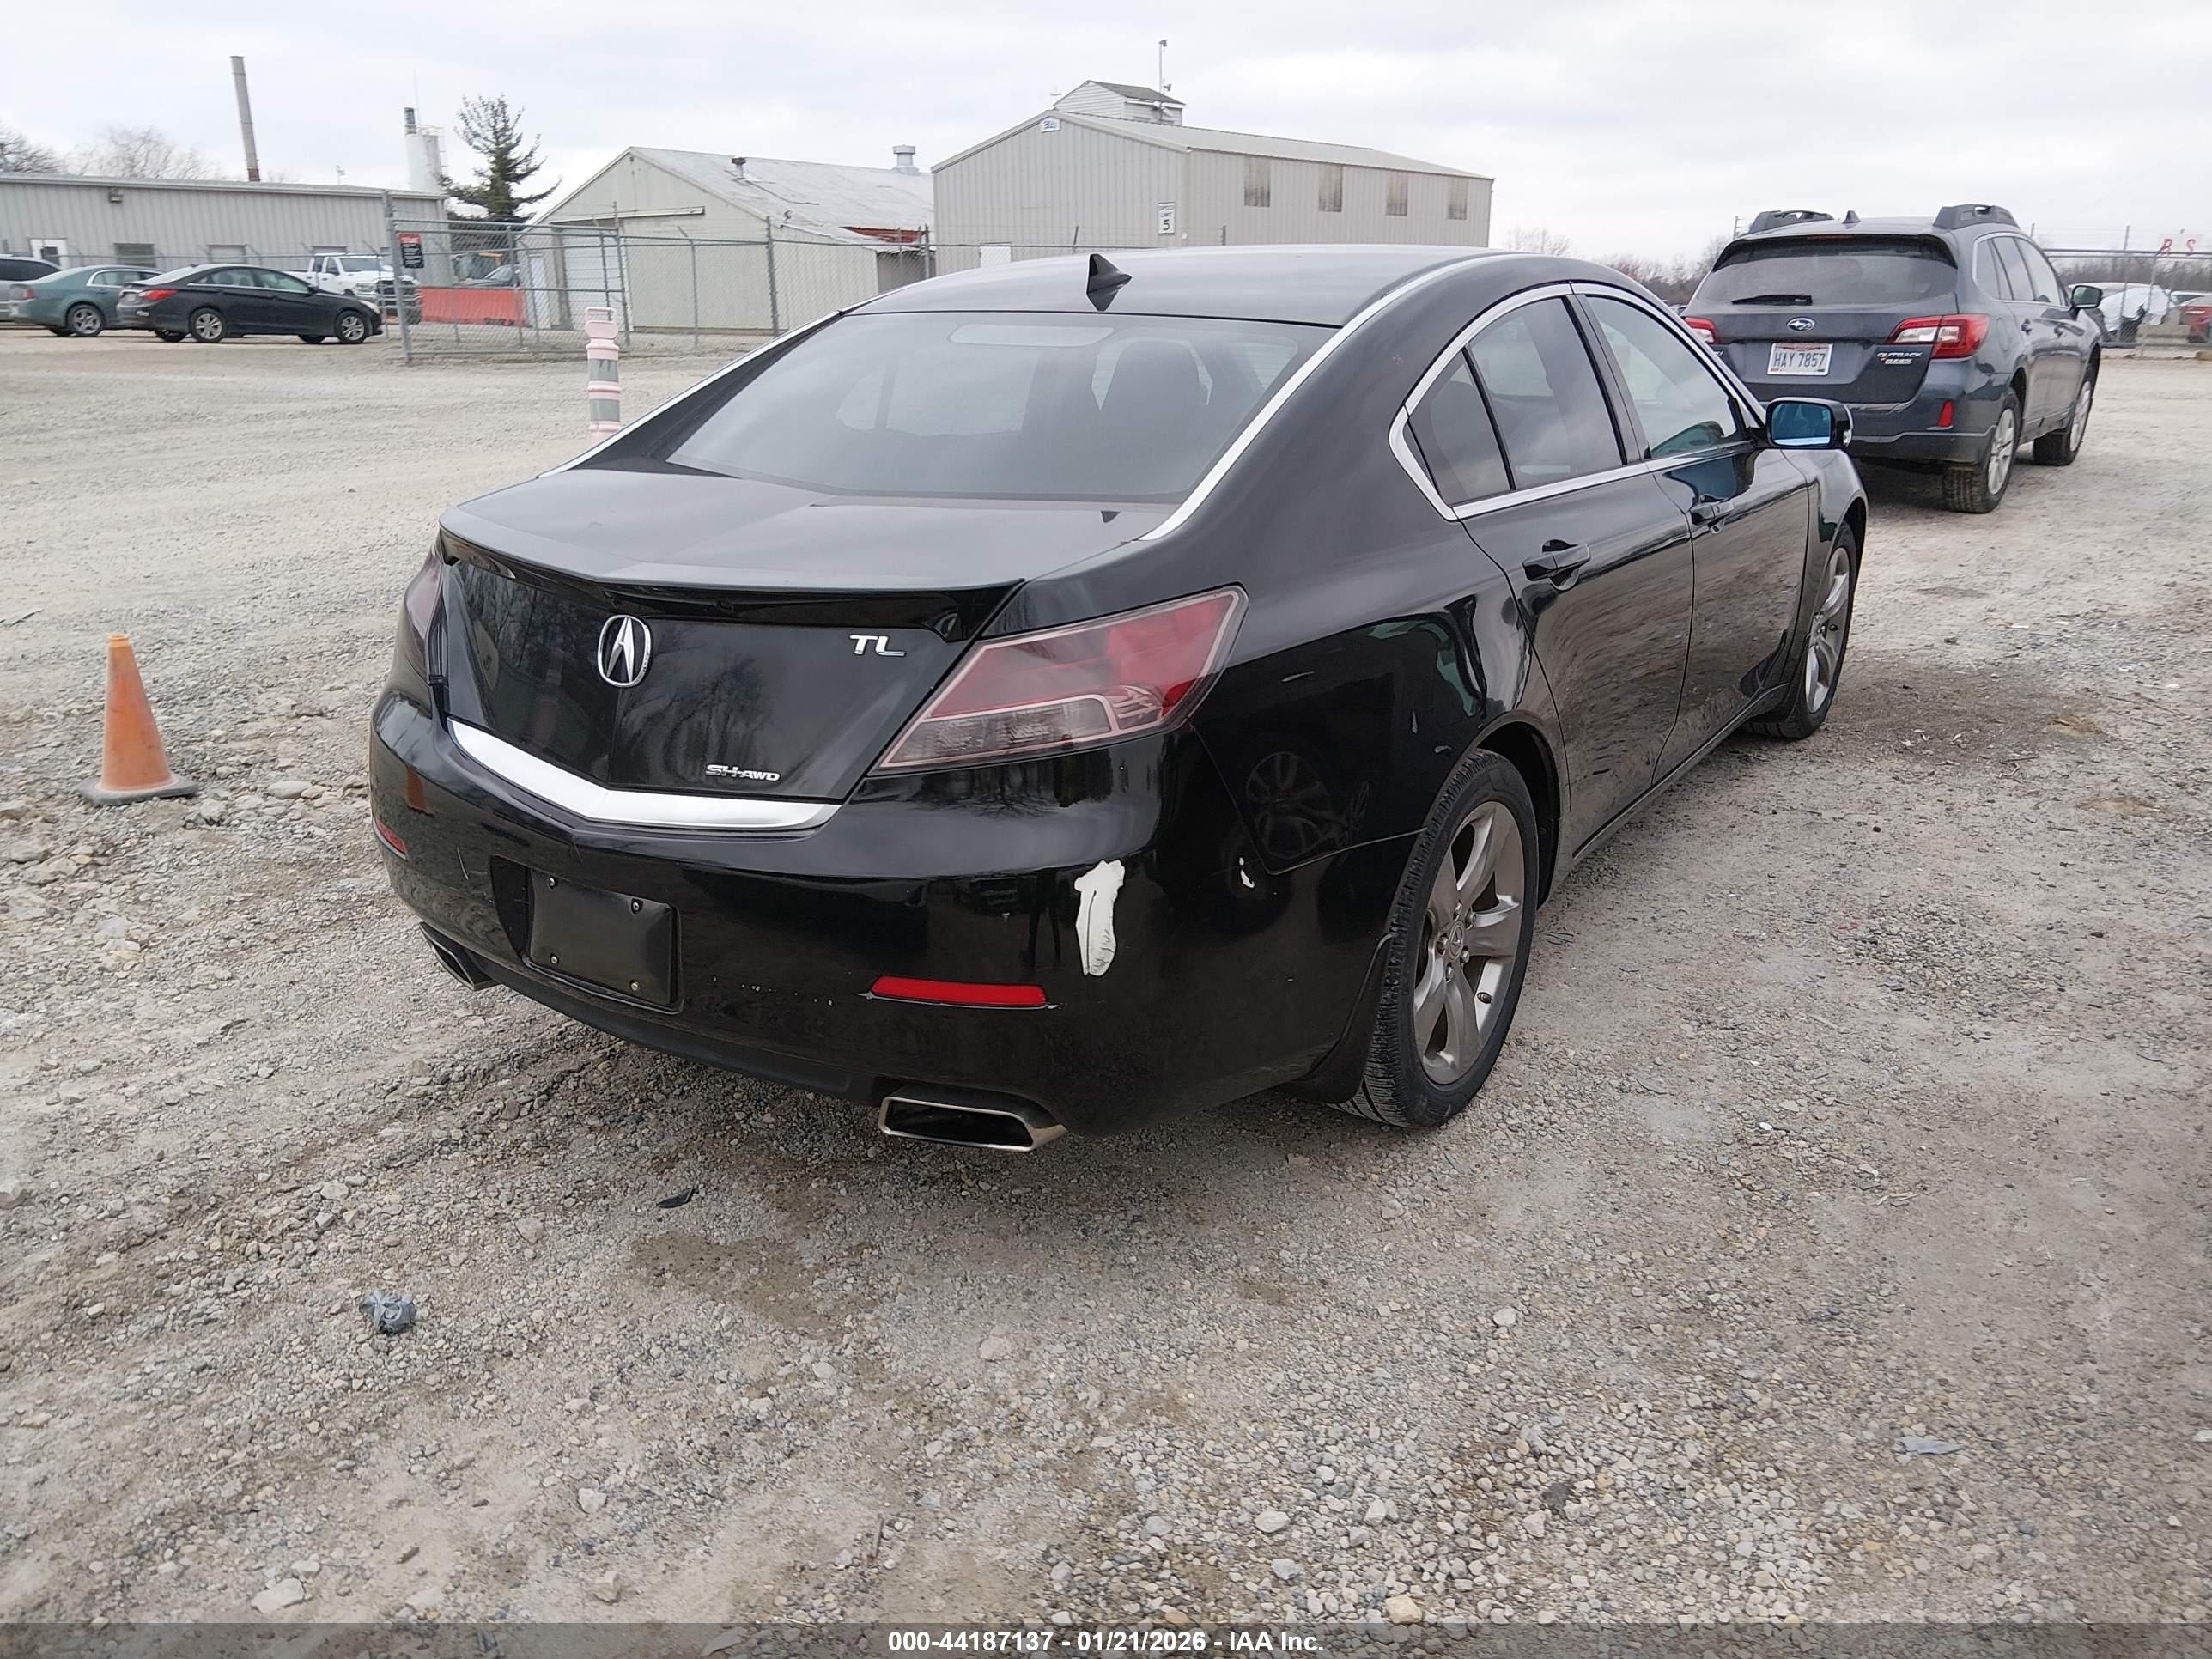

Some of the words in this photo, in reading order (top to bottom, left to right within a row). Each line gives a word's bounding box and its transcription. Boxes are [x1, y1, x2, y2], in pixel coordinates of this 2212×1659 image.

[1163, 219, 1170, 231] 5
[1773, 353, 1795, 368] HAY
[1798, 353, 1826, 368] 7857
[849, 635, 906, 657] TL
[705, 764, 781, 781] SH-AWD
